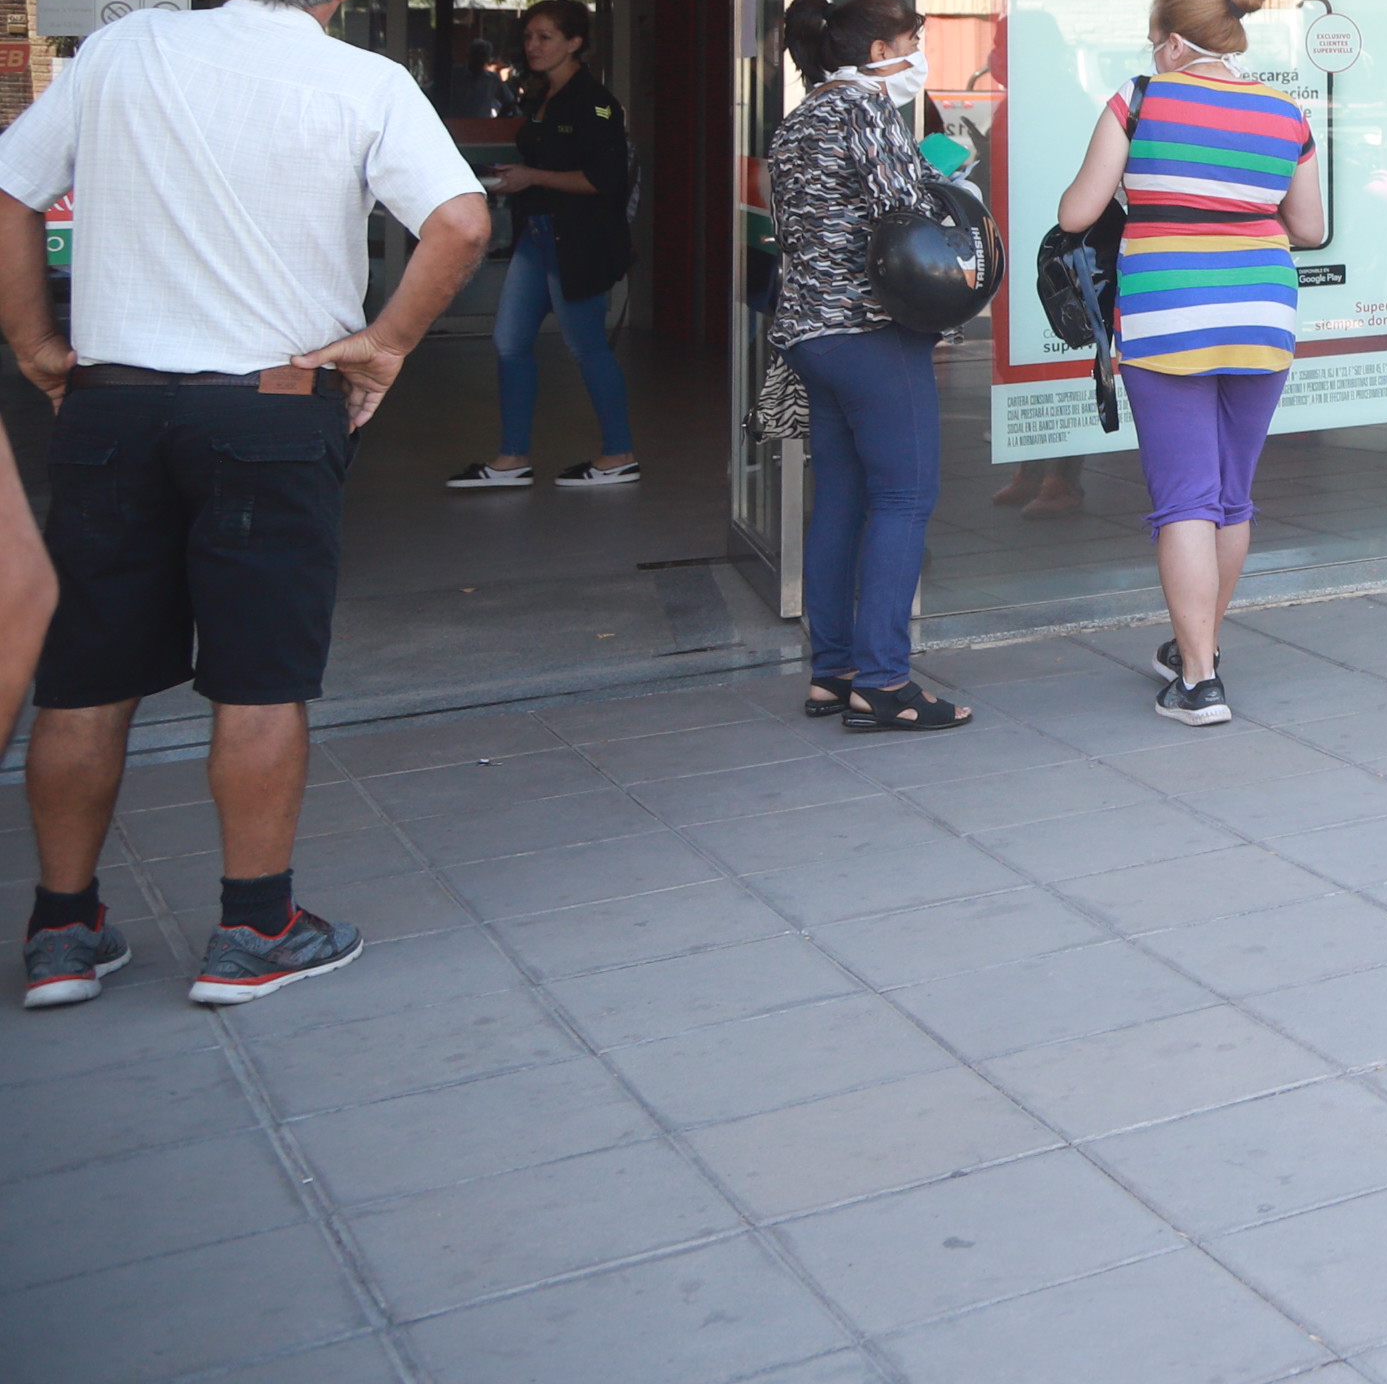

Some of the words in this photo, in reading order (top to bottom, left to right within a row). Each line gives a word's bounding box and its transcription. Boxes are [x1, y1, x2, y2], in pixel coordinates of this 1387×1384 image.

[1240, 67, 1299, 85] escargá
[970, 226, 985, 290] TAMASHI
[1298, 274, 1326, 284] Google
[1326, 273, 1343, 283] Play
[1314, 318, 1364, 331] siempre
[1007, 395, 1028, 407] CARTERA
[1007, 422, 1023, 434] SOCIAL
[1024, 421, 1031, 432] EN
[1038, 419, 1054, 431] BANCO
[1082, 415, 1088, 426] LA
[1007, 437, 1011, 447] A
[1012, 436, 1018, 447] LA
[1019, 433, 1047, 446] NORMATIVA
